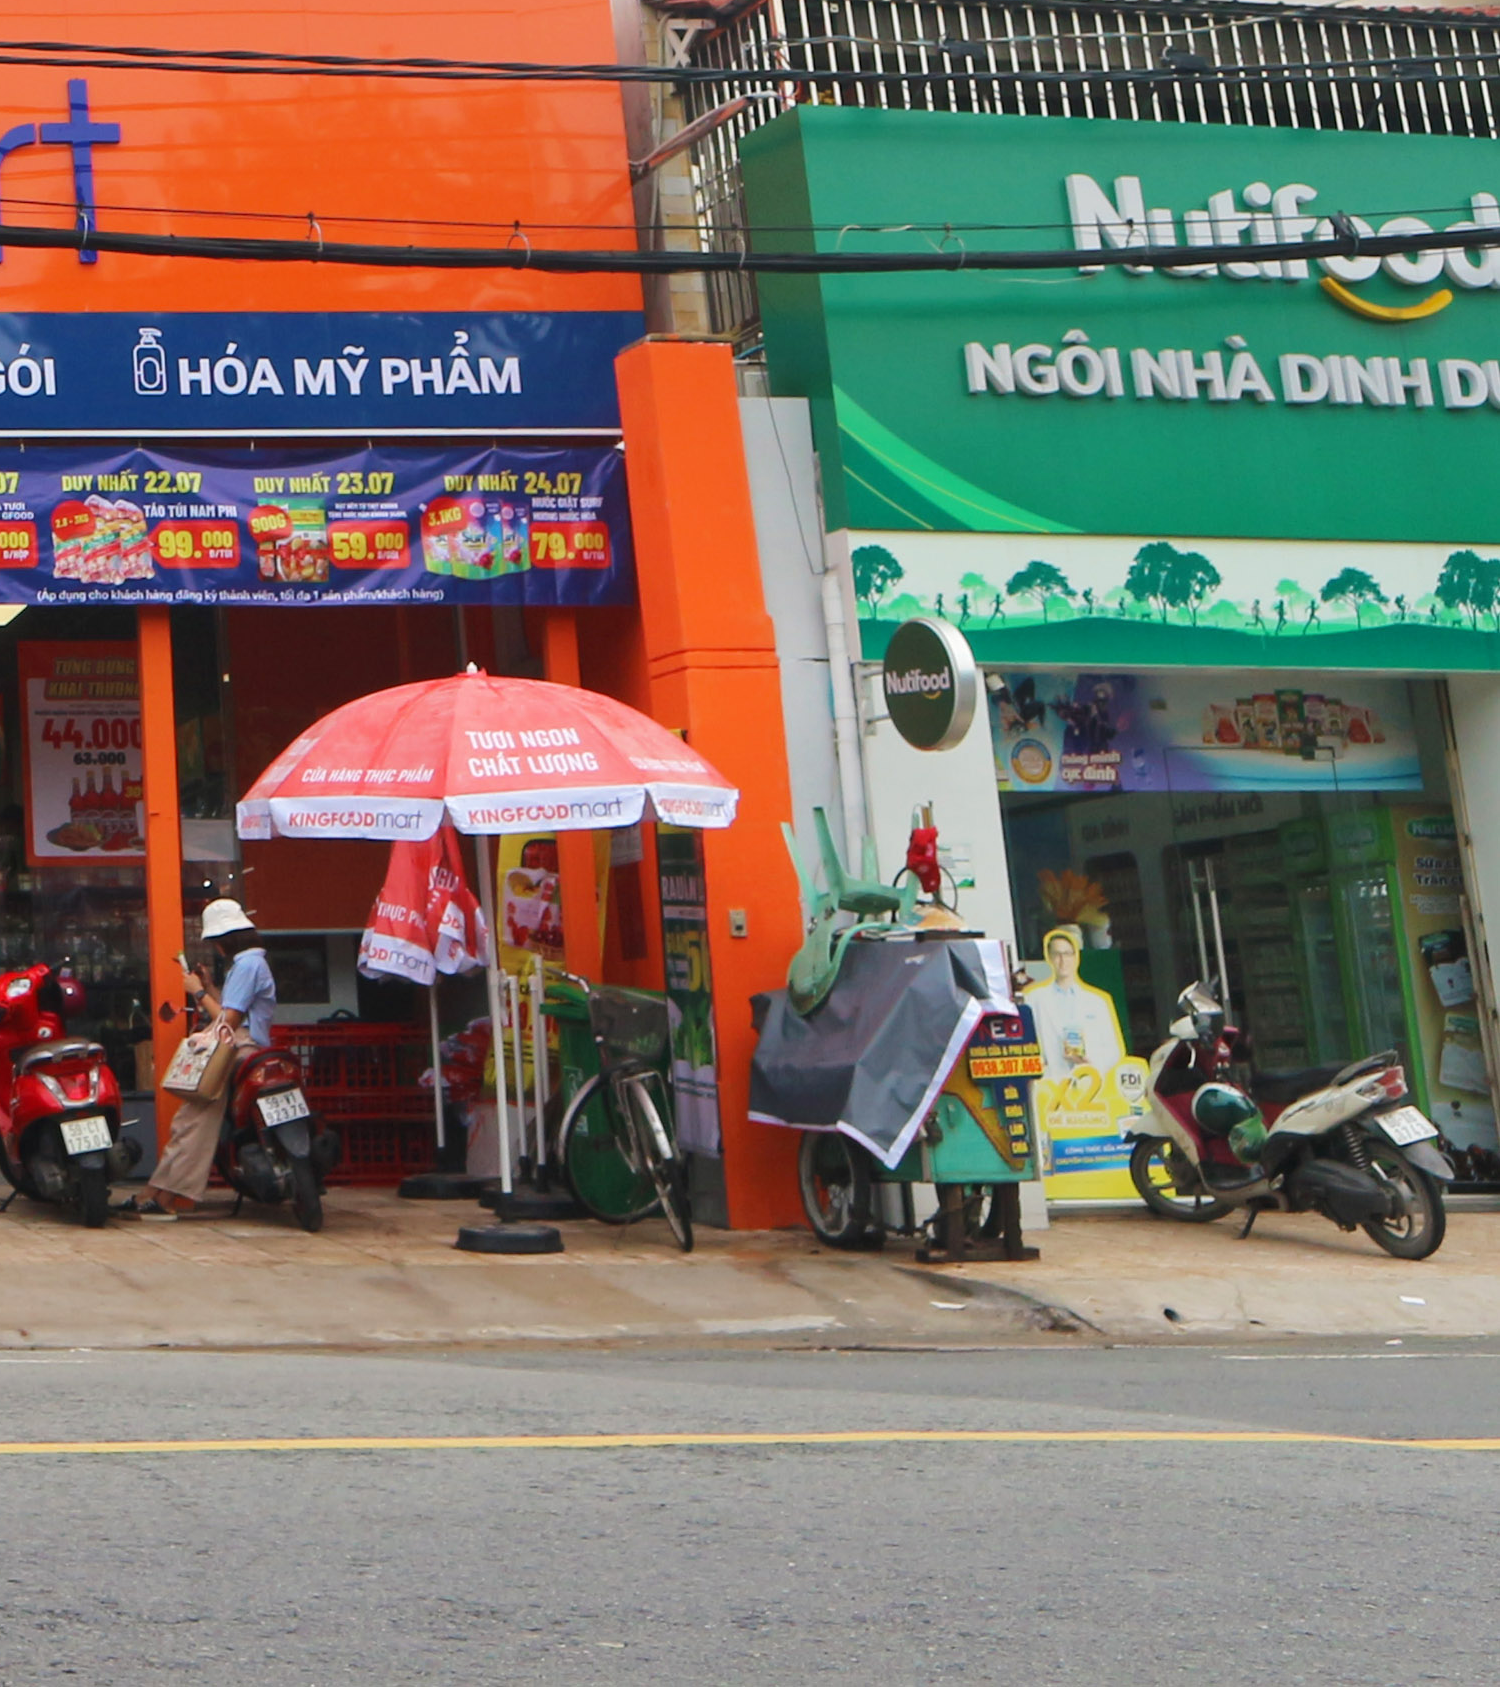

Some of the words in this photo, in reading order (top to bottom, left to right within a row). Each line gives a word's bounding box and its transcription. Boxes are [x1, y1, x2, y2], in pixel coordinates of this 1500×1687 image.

[178, 342, 285, 396] HÓA
[293, 345, 371, 396] MỸ
[380, 330, 522, 396] PHẨM
[962, 328, 1124, 401] NGÔI
[1130, 334, 1276, 403] NHÀ
[1278, 351, 1435, 408] DINH
[61, 474, 93, 492] DUY
[97, 468, 139, 492] NHẤT
[143, 470, 202, 494] 22.07
[253, 476, 285, 494] DUY
[289, 470, 331, 494] NHẤT
[336, 472, 394, 495] 23.07
[443, 474, 474, 493] DUY
[477, 469, 519, 493] NHẤT
[524, 471, 583, 495] 24.07
[1, 511, 35, 520] GFOOD
[3, 501, 26, 512] TƯƠI
[142, 499, 167, 518] TÁO
[167, 501, 187, 518] TÚI
[188, 504, 216, 518] NAM
[428, 507, 462, 526] 3.1KG
[251, 513, 287, 534] 900G
[58, 590, 87, 603] dụng
[88, 589, 109, 600] cho
[111, 589, 144, 601] khách
[145, 589, 174, 602] hàng
[175, 589, 203, 602] đăng
[204, 589, 218, 602] ký
[219, 589, 251, 601] thành
[885, 665, 951, 695] Nutifood
[465, 729, 516, 751] TƯƠI
[520, 726, 581, 748] NGON
[301, 766, 327, 783] CỬA
[328, 766, 362, 783] HÀNG
[362, 766, 399, 785] THỰC
[399, 763, 435, 784] PHẨM
[467, 750, 524, 780] CHẤT
[527, 750, 600, 779] LƯỢNG
[288, 809, 424, 831] KINGFOODmart
[467, 796, 624, 825] KINGFOODmart
[1120, 1072, 1142, 1087] FDI
